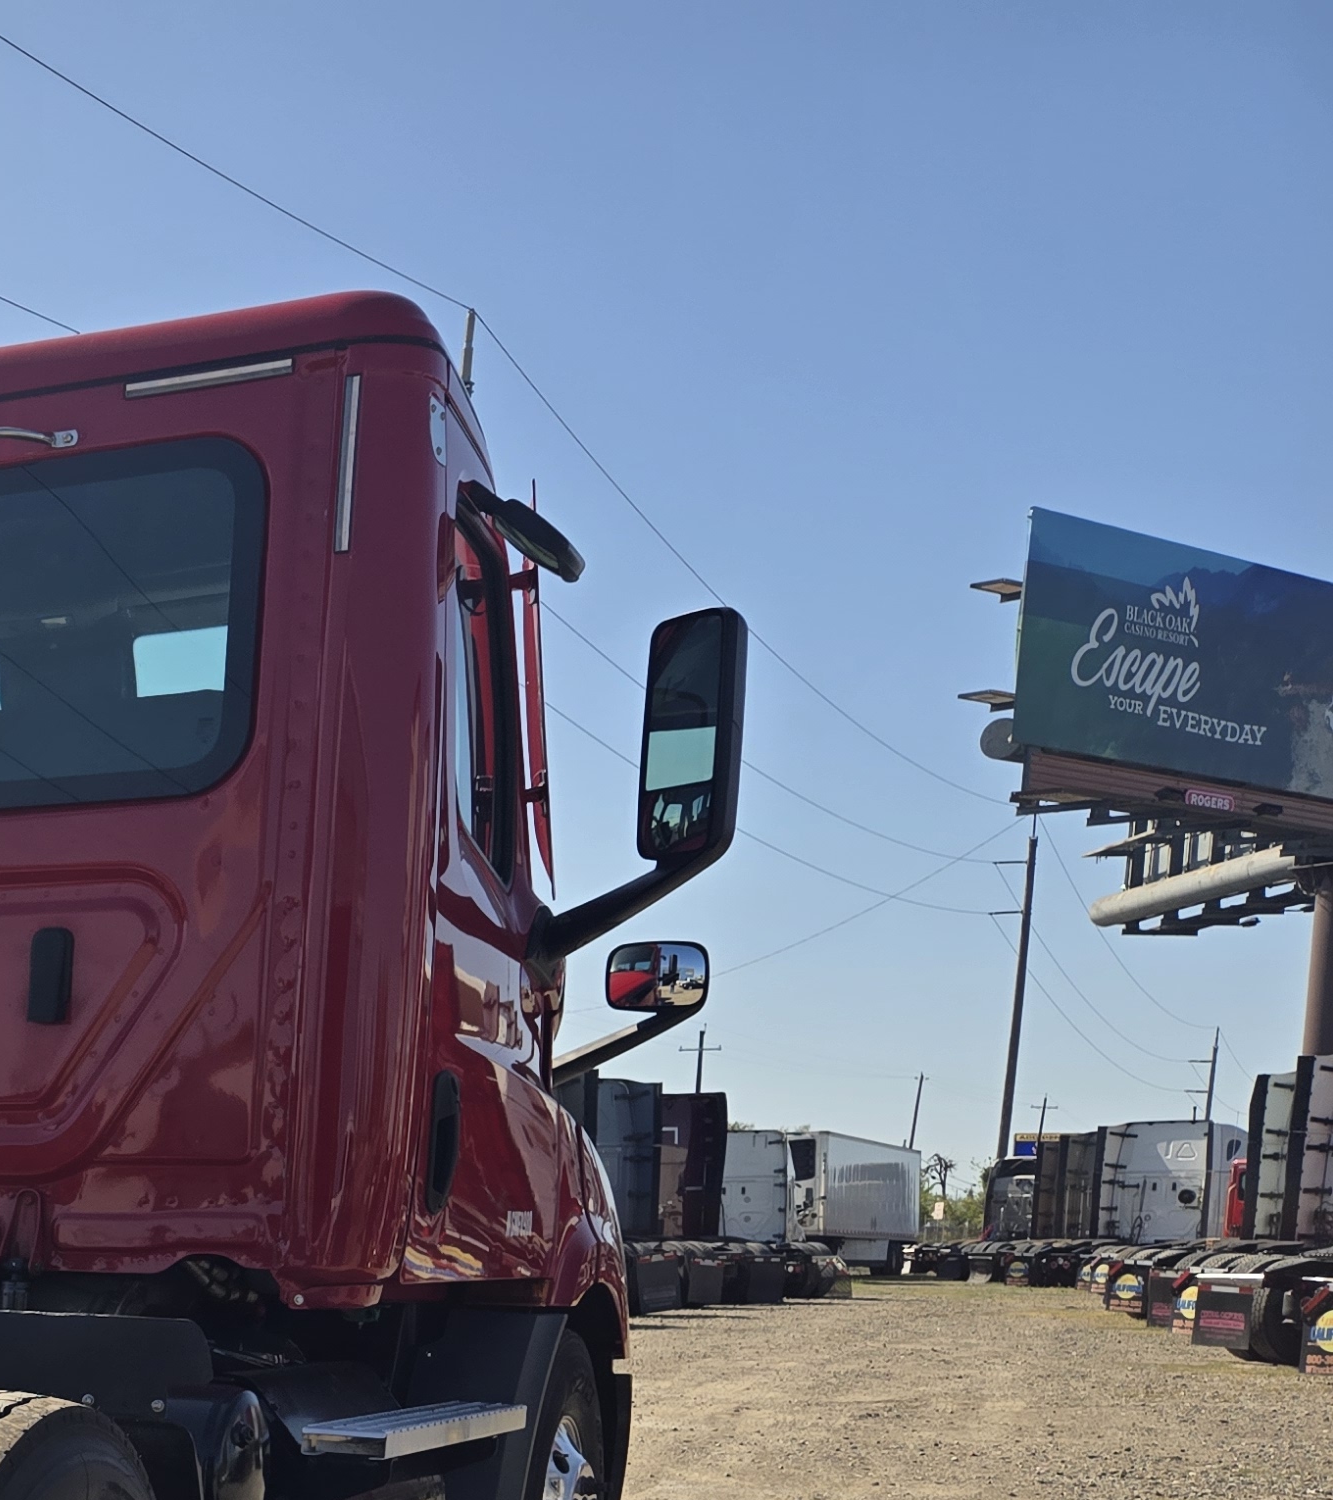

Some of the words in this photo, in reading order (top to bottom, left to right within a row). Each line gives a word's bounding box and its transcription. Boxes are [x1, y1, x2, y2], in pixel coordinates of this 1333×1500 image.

[1124, 622, 1156, 639] CASINO
[1157, 629, 1189, 646] RESORT
[1126, 605, 1164, 628] BLACK
[1166, 614, 1190, 634] OAK
[1071, 608, 1200, 717] Escape
[1109, 695, 1143, 715] YOUR
[1157, 706, 1267, 745] EVERYDAY
[1190, 793, 1231, 811] ROGERS
